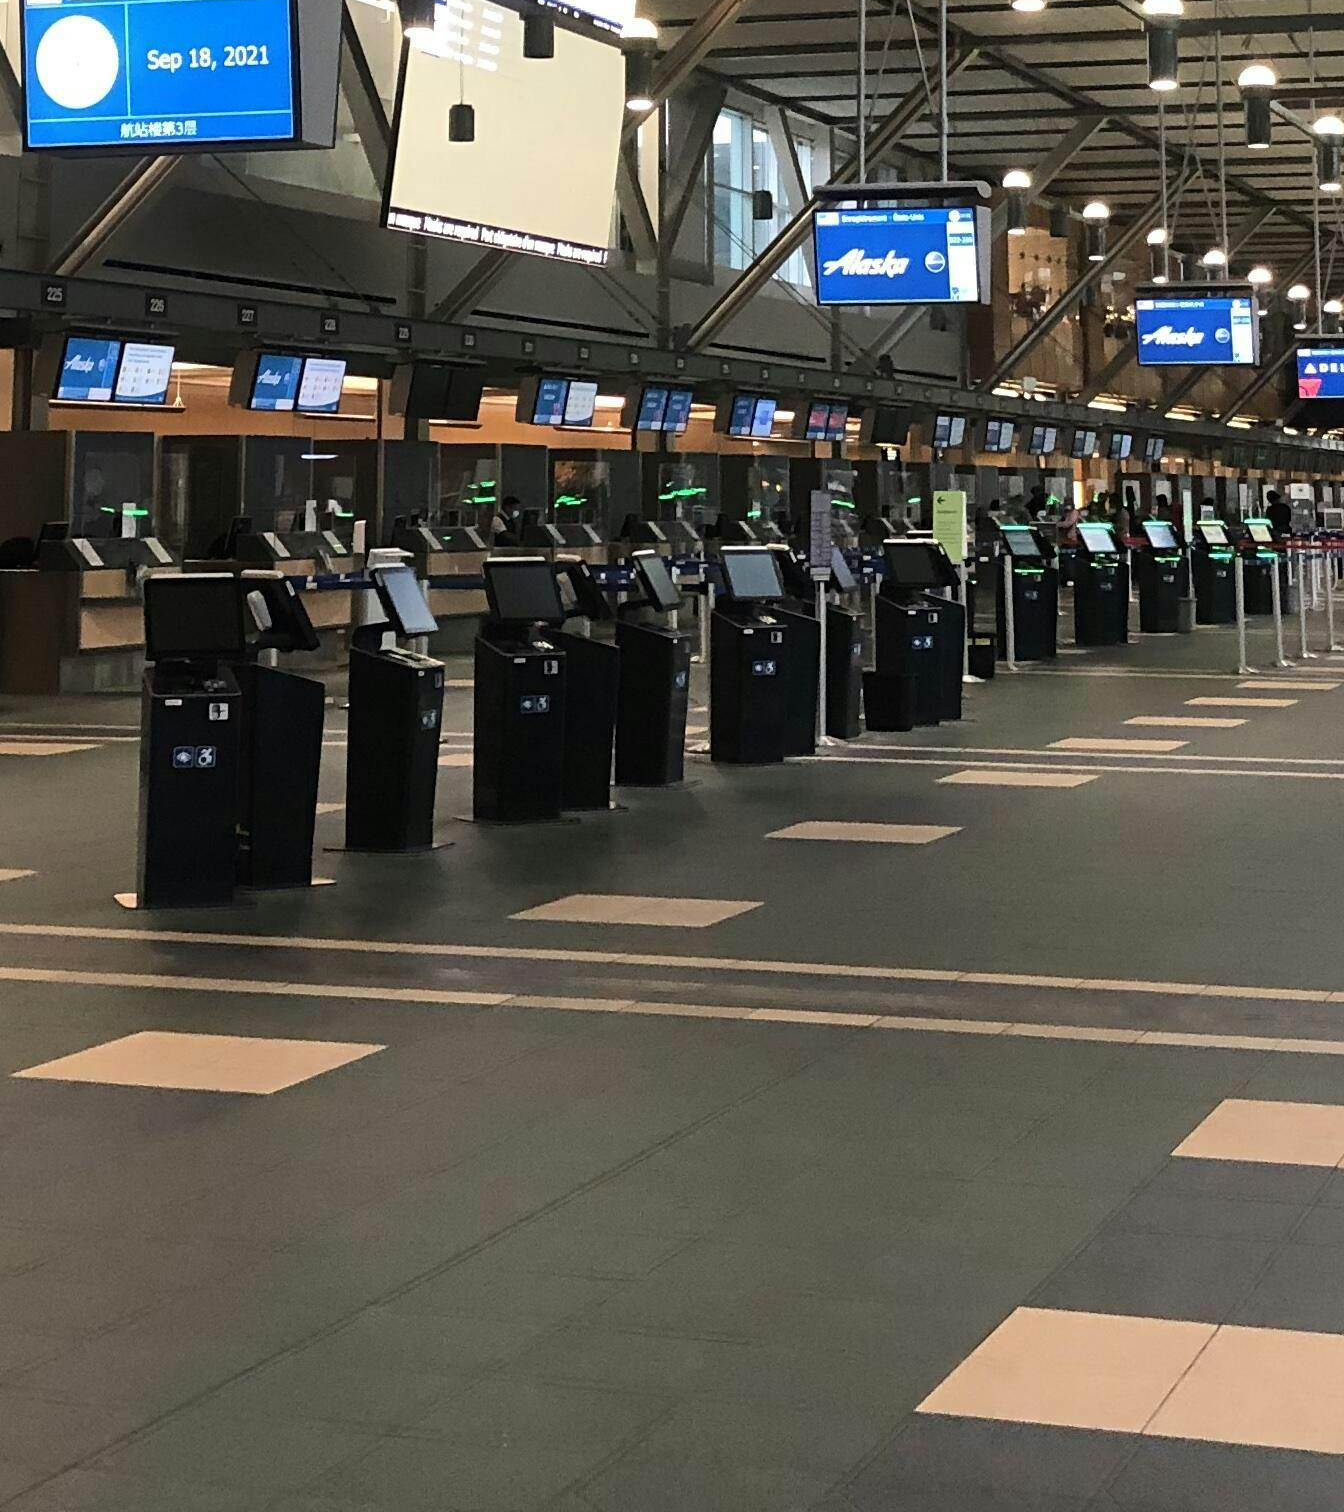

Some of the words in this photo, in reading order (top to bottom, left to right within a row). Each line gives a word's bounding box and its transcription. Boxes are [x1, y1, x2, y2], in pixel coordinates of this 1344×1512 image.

[147, 49, 183, 73] Sep
[189, 47, 217, 71] 18,
[223, 45, 269, 67] 2021
[823, 248, 910, 279] Alaska
[47, 286, 63, 302] 225
[150, 298, 165, 313] 226
[1142, 325, 1205, 347] Alaska
